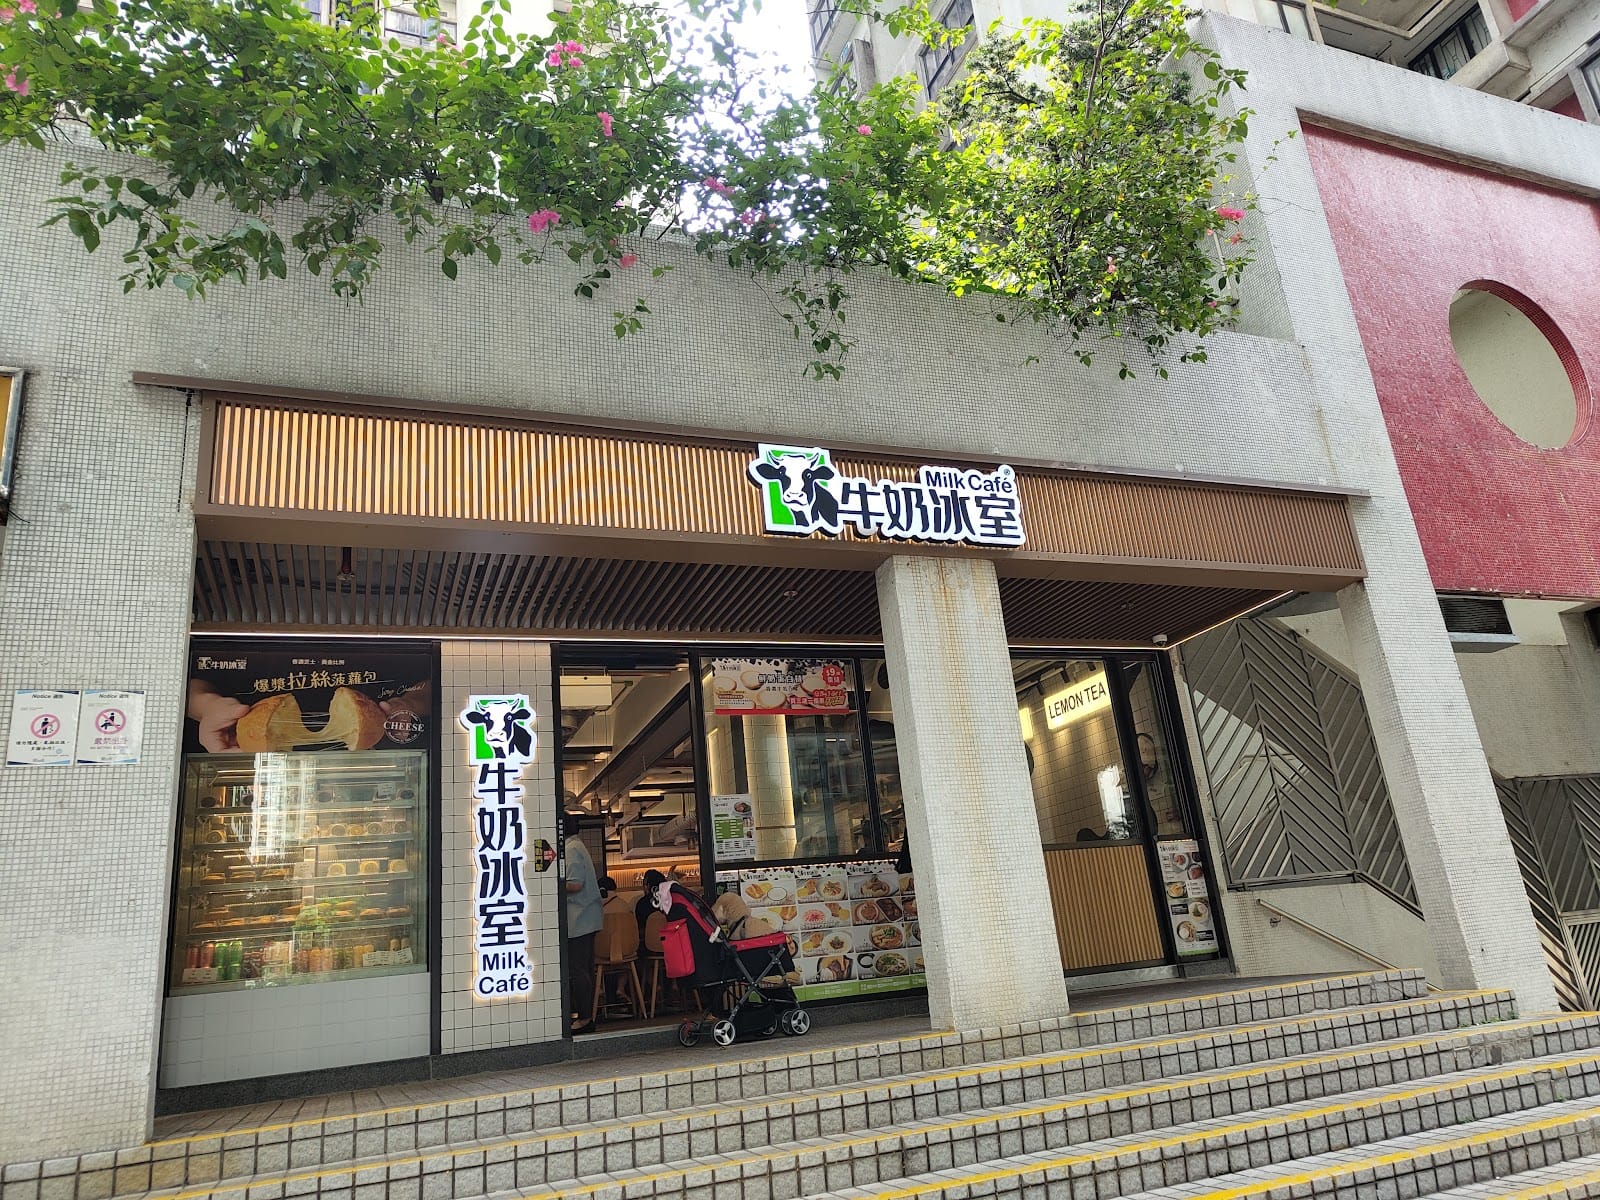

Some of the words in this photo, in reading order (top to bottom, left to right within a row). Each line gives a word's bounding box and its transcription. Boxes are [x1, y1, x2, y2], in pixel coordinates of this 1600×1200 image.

[926, 470, 965, 490] Milk
[968, 473, 1012, 494] Café
[837, 481, 1021, 539] 牛奶冰室
[1048, 691, 1084, 719] LEMON
[1085, 682, 1107, 701] TEA
[383, 721, 425, 732] CHEESE
[478, 762, 525, 948] 牛奶冰室
[482, 952, 525, 972] Milk
[479, 975, 529, 994] Café
